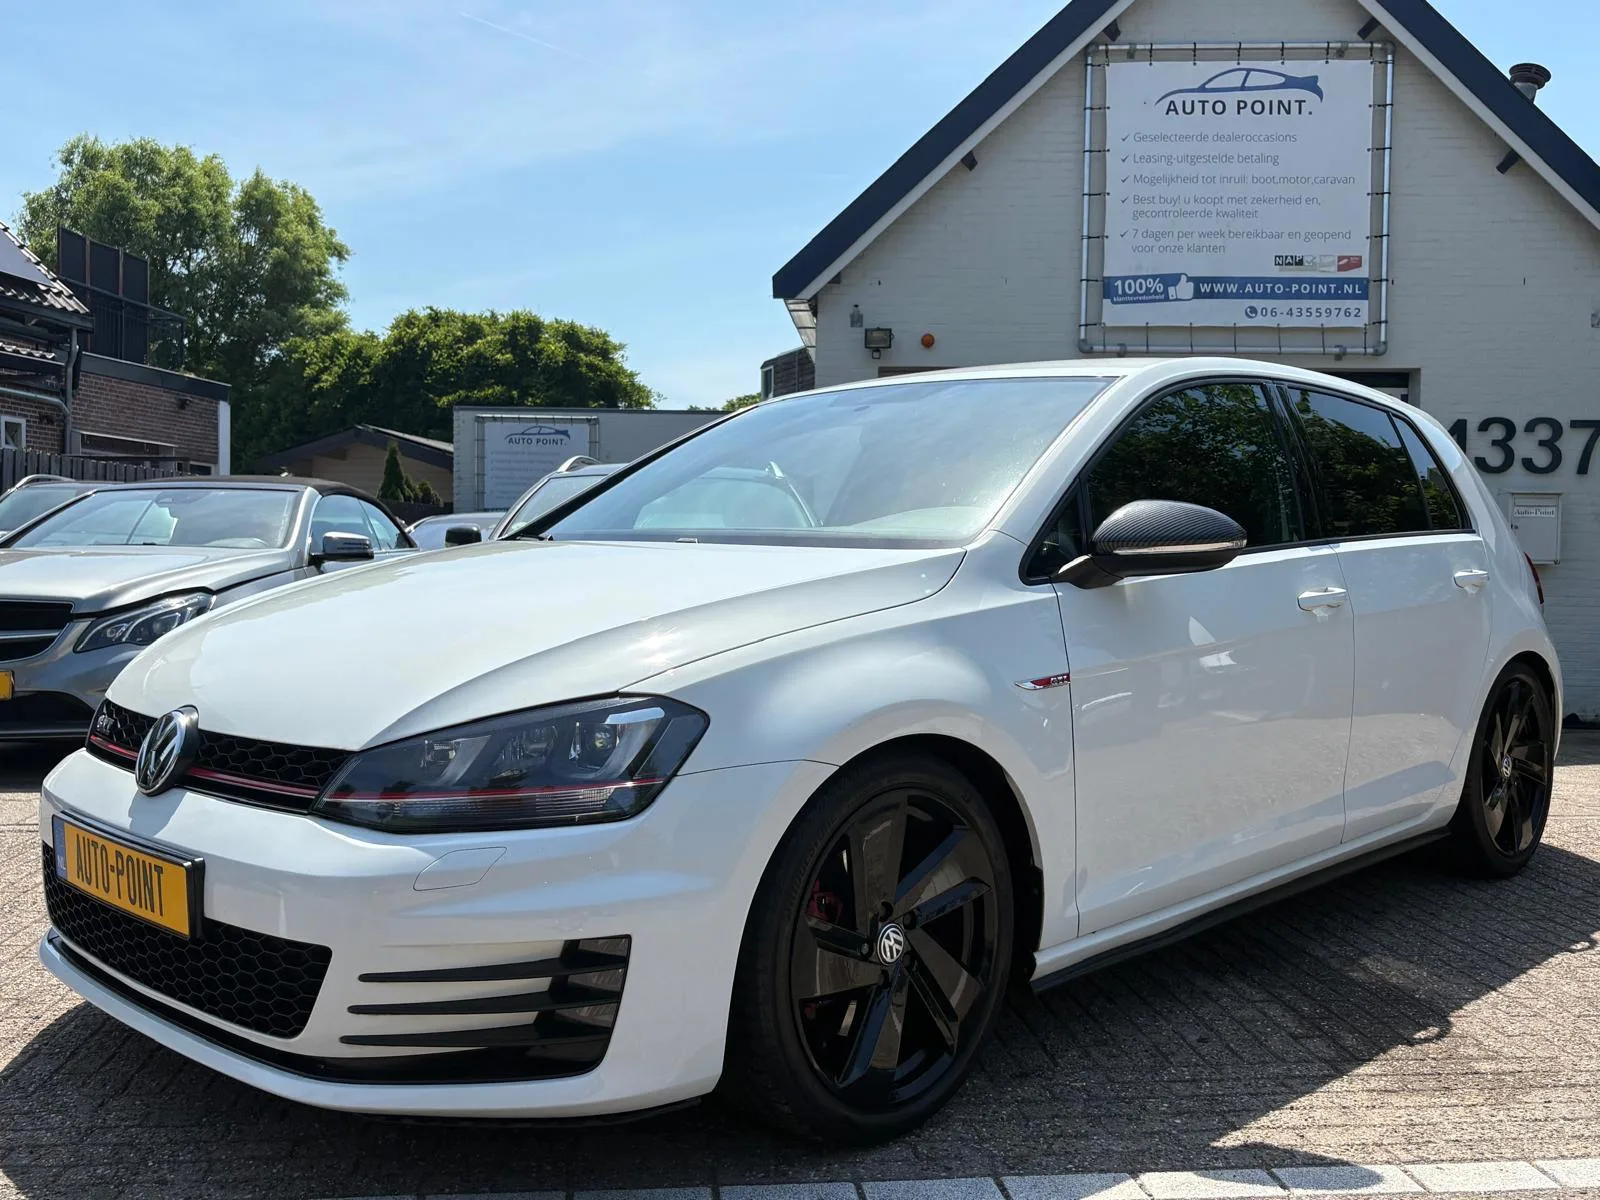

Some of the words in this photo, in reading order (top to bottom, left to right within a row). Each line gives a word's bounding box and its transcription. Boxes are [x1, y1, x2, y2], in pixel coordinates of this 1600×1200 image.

[1165, 99, 1227, 116] AUTO
[1133, 131, 1209, 143] Geselecteerde
[1212, 131, 1298, 143] dealeroccasions
[1237, 152, 1280, 166] betaling
[1133, 173, 1199, 187] Mogelijkheid
[1202, 174, 1217, 185] tot
[1133, 194, 1156, 205] Best
[1159, 194, 1181, 207] buy!
[1183, 196, 1191, 205] u
[1193, 194, 1224, 207] koopt
[1227, 195, 1248, 205] met
[1250, 194, 1302, 206] zekerheid
[1132, 208, 1213, 221] gecontroleerde
[1216, 208, 1259, 219] kwaliteit
[1132, 228, 1139, 239] 7
[1141, 228, 1174, 242] dagen
[1177, 230, 1196, 242] per
[1198, 228, 1226, 240] week
[1228, 228, 1285, 240] bereikbaar
[1287, 230, 1301, 240] en
[1303, 229, 1352, 243] geopend
[1131, 243, 1156, 254] voor
[1158, 243, 1184, 254] onze
[1186, 242, 1226, 254] klanten
[1114, 278, 1164, 295] 100%
[1199, 283, 1362, 294] WWW.AUTO-POINT.NL
[1260, 307, 1361, 318] 06-43559762
[508, 437, 533, 445] AUTO
[56, 855, 67, 871] NL
[76, 833, 164, 917] AUTO-POINT
